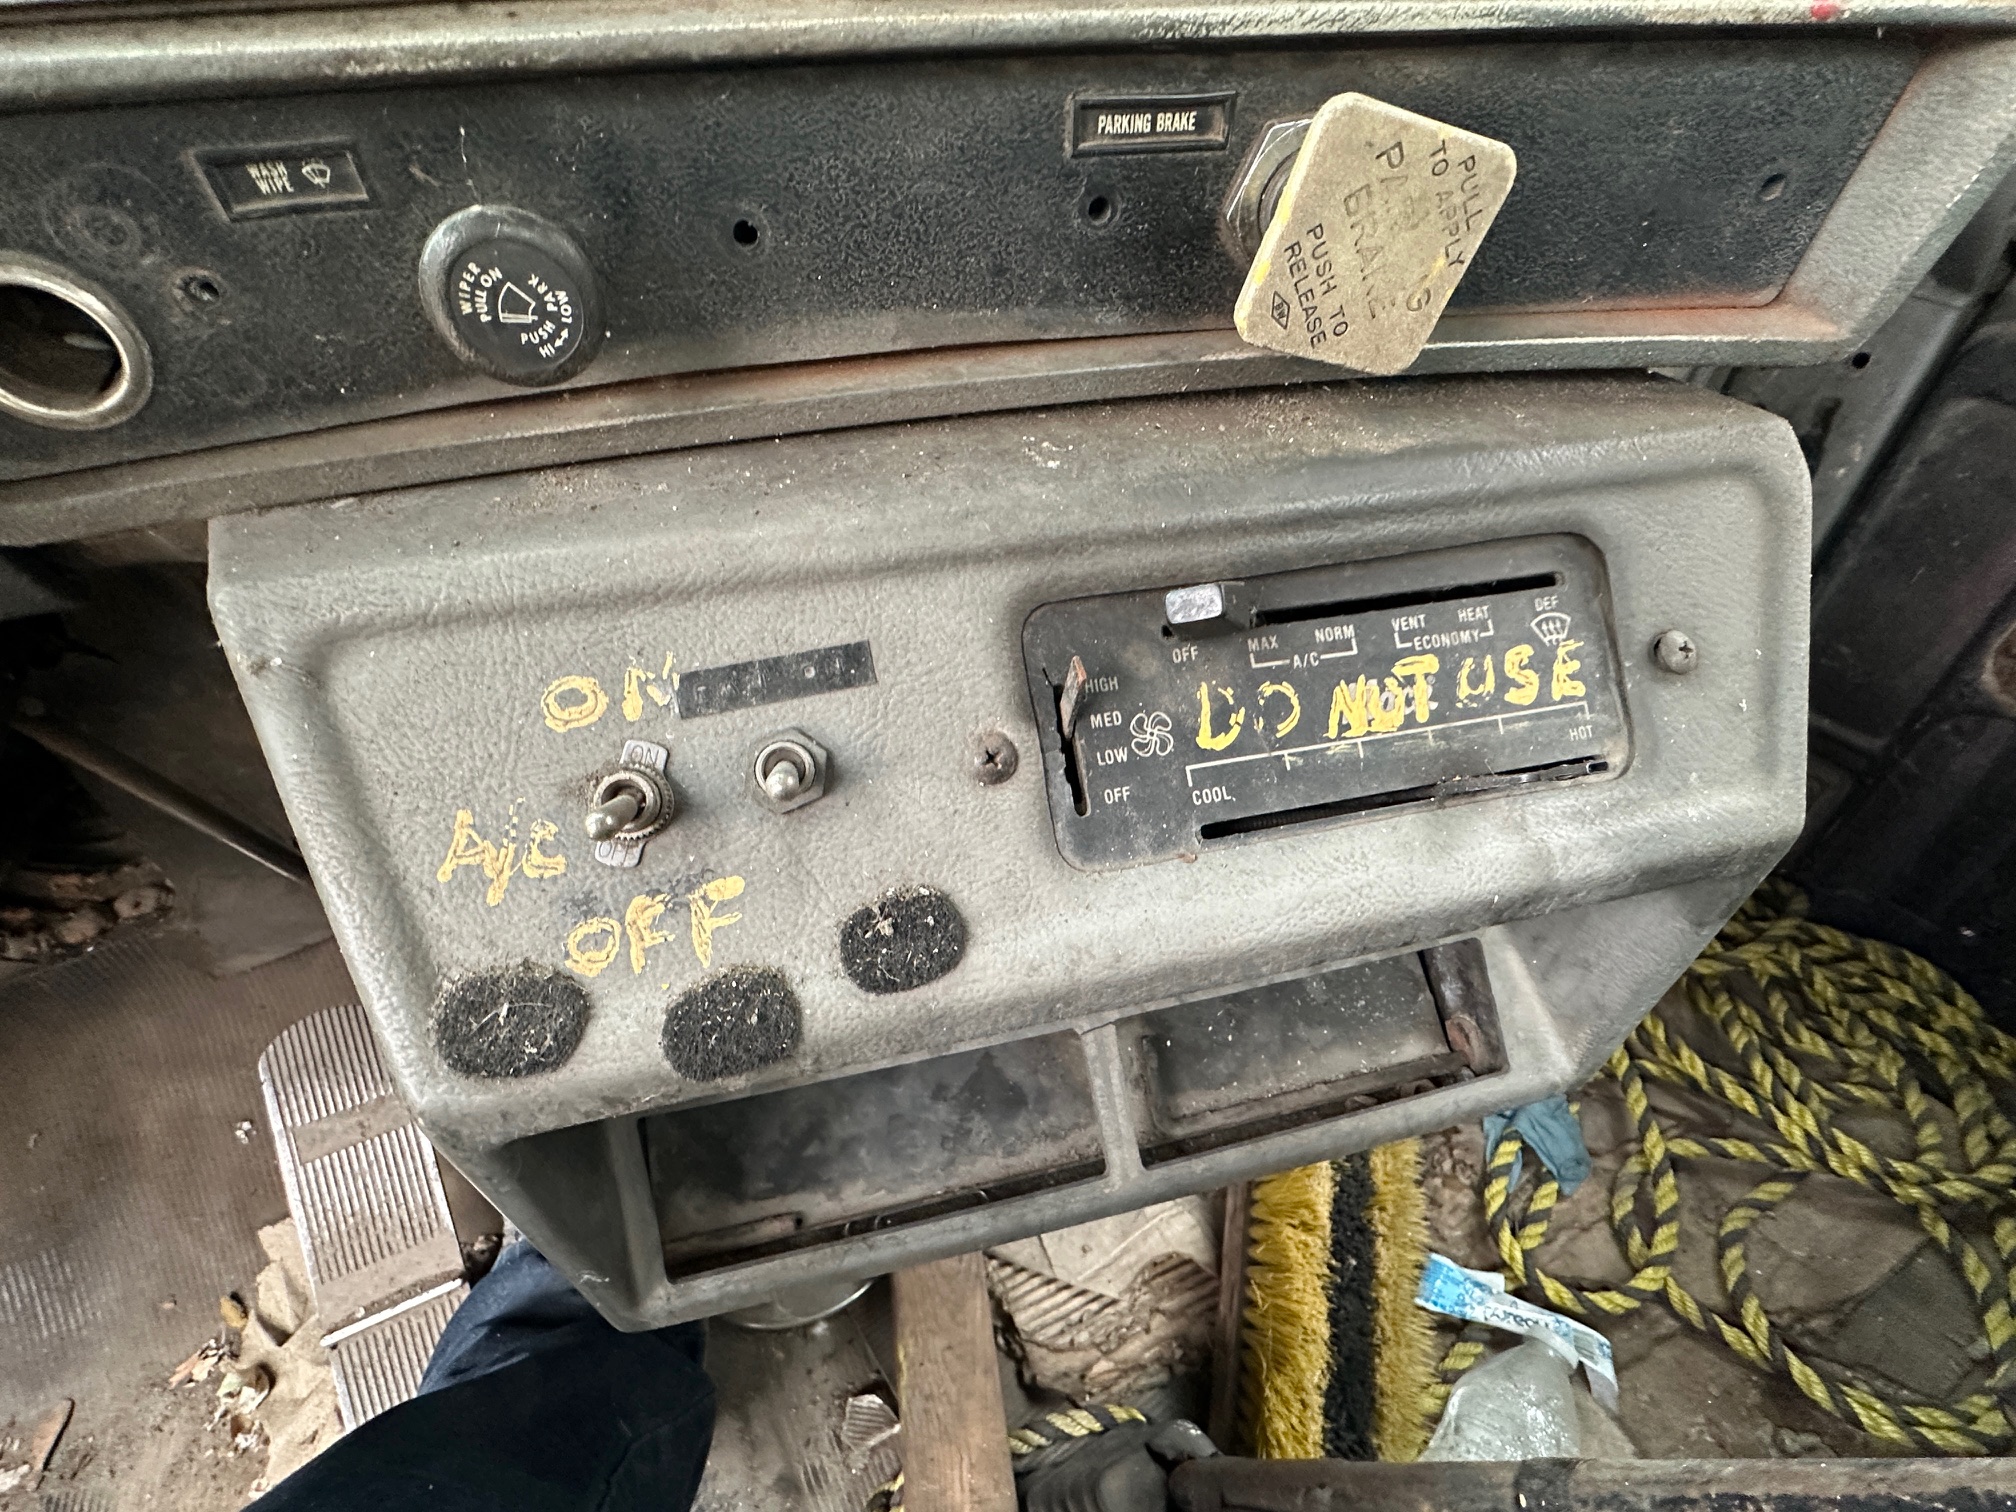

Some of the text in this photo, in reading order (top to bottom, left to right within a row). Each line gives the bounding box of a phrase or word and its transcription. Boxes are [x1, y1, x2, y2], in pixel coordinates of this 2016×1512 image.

[1098, 110, 1198, 135] PARKING BRAKE
[245, 159, 288, 180] WASH
[255, 175, 295, 195] WIPE
[1457, 154, 1484, 232] PULL
[1429, 139, 1466, 268] TO APPLY
[458, 261, 482, 316] WIPER
[1305, 222, 1349, 338] PUSH TO
[474, 266, 503, 323] PULL ON
[1283, 240, 1327, 349] RELEASE
[520, 273, 559, 346] PUSH PARK
[538, 290, 573, 359] HI LOW
[1535, 596, 1559, 612] DEF
[1391, 604, 1490, 632] VENT HEAT
[1247, 624, 1355, 652] MAX NORM
[1413, 628, 1480, 651] ECONOMY
[1172, 645, 1199, 664] OFF
[1292, 650, 1320, 669] A/C
[1085, 675, 1119, 694] HIGH
[1455, 639, 1587, 708] USE
[1090, 710, 1122, 730] MED
[1568, 725, 1594, 742] HOT
[630, 744, 660, 766] ON
[1097, 746, 1128, 766] LOW
[1104, 785, 1131, 805] OFF
[1191, 787, 1233, 806] COOL
[436, 797, 568, 907] A/C
[564, 874, 746, 978] OFF
